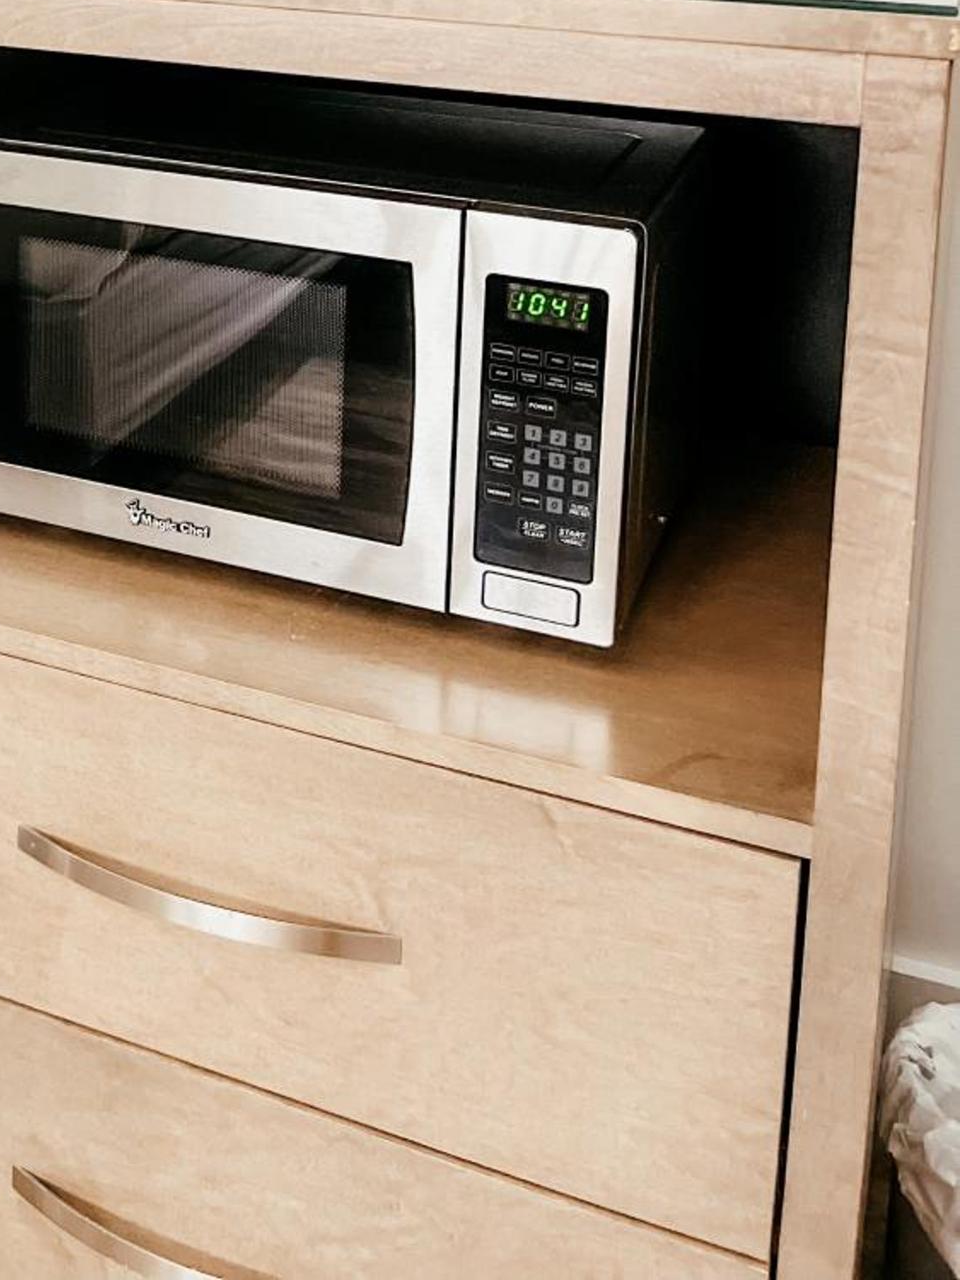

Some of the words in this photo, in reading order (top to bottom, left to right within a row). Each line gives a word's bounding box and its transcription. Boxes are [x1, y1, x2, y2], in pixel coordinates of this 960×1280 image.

[141, 513, 178, 532] Magic
[179, 522, 211, 538] Chef
[522, 521, 547, 531] STOP
[558, 528, 587, 539] START
